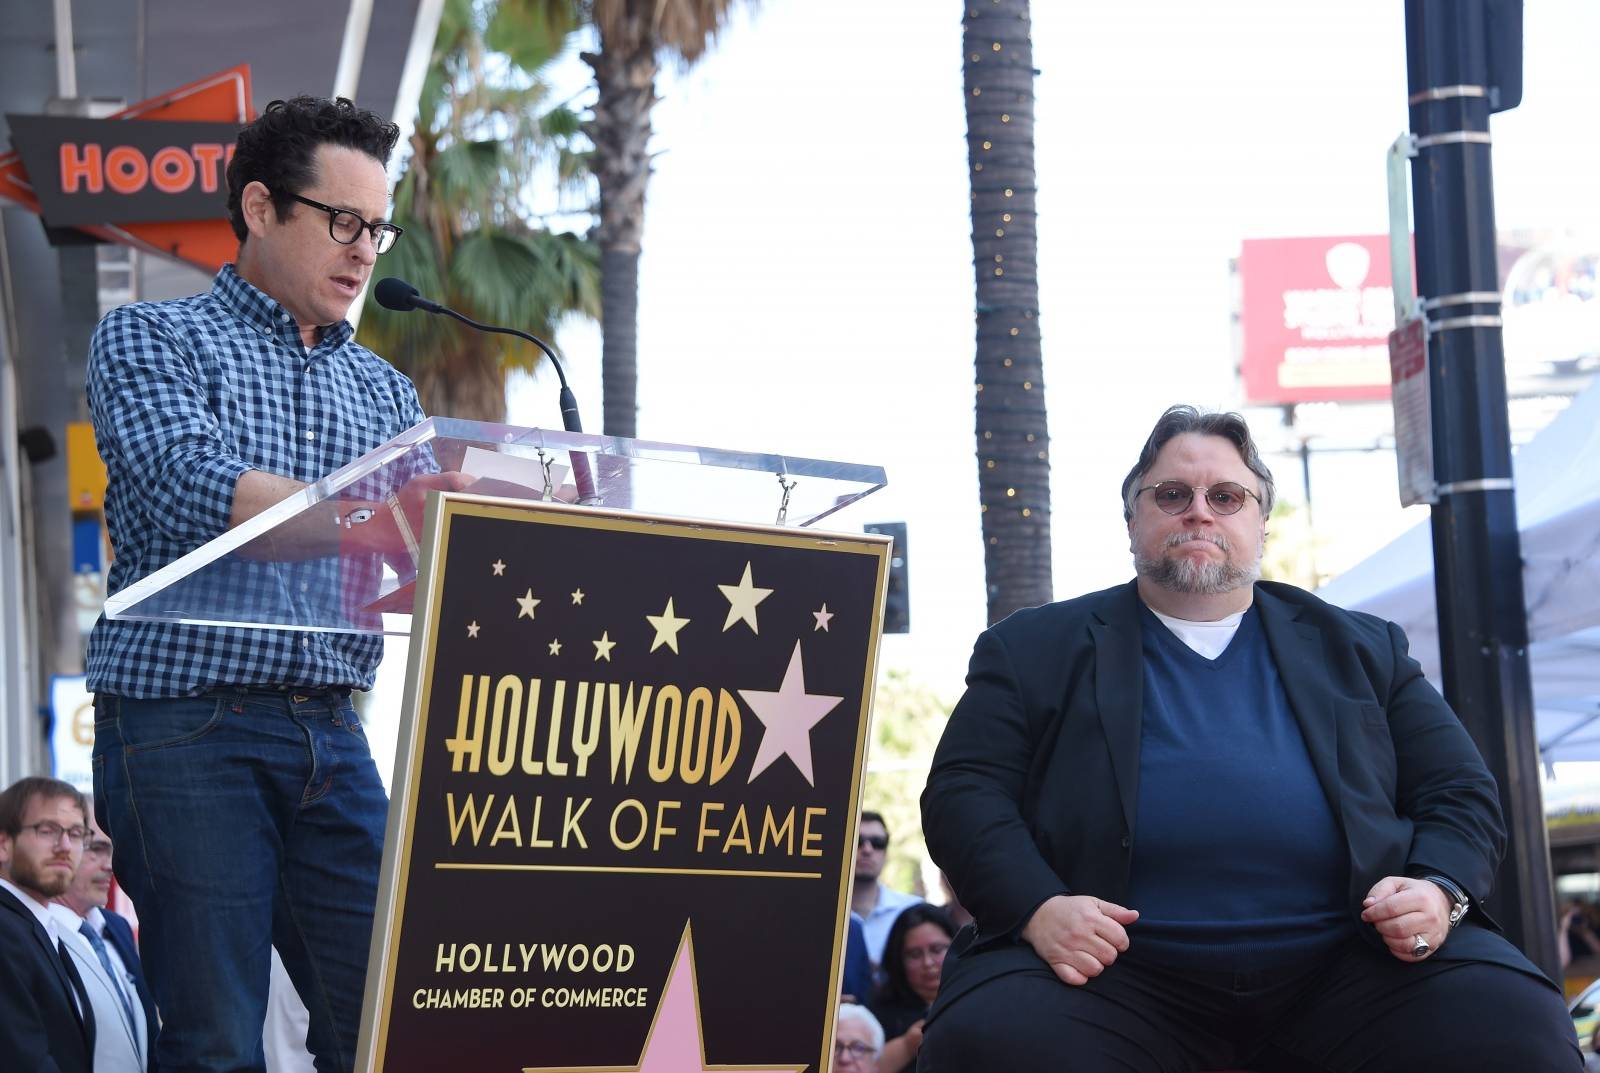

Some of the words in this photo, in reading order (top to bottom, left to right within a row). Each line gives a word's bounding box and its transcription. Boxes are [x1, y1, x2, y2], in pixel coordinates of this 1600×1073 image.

[60, 143, 235, 194] HOOT
[446, 675, 741, 785] HOLLYWOOD
[447, 793, 592, 848] WALK
[610, 799, 681, 850] OF
[697, 803, 826, 856] FAME
[436, 943, 634, 972] HOLLYWOOD
[413, 989, 504, 1008] CHAMBER
[510, 988, 536, 1007] OF
[542, 988, 647, 1007] COMMERCE
